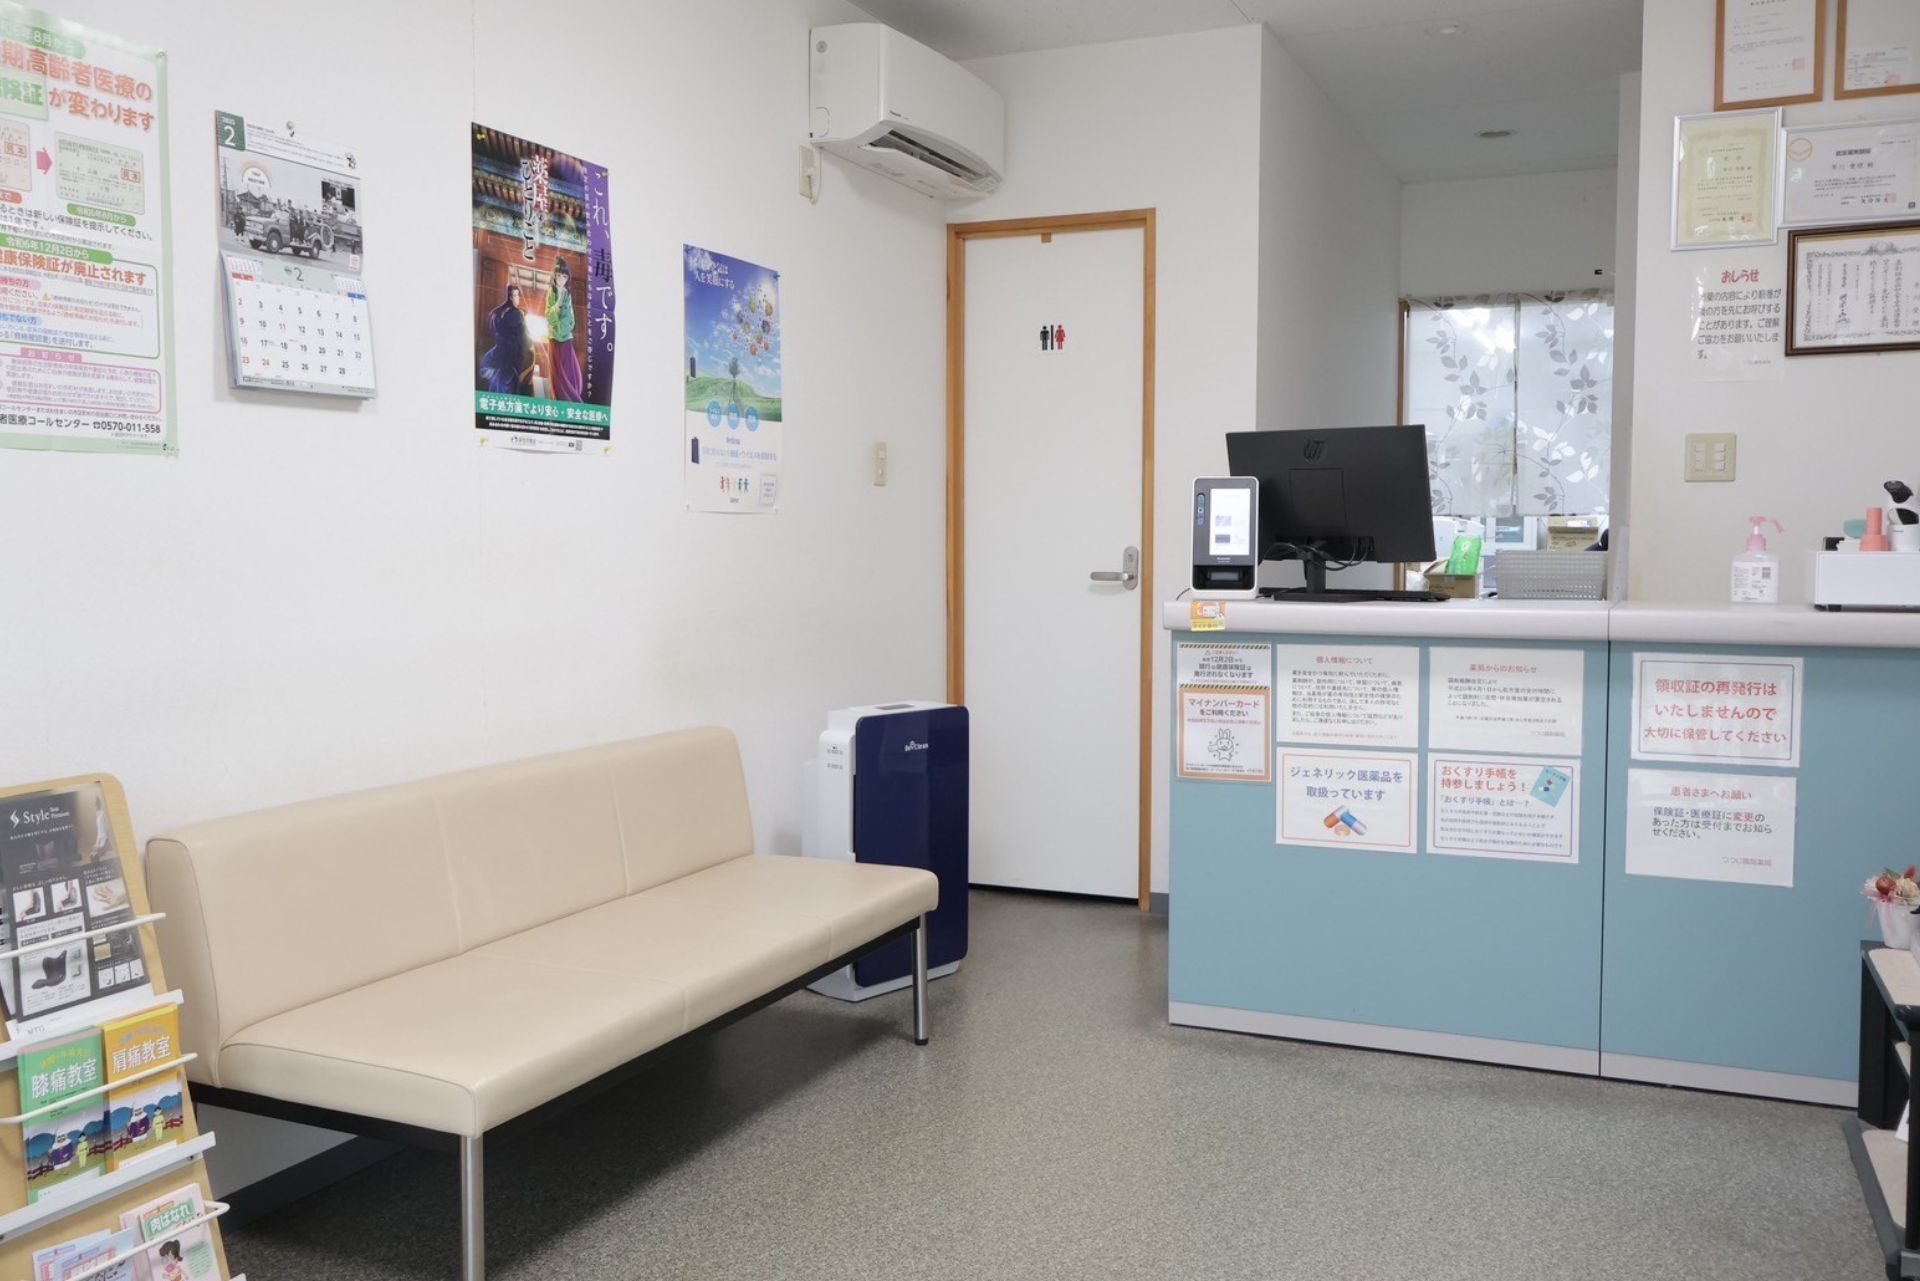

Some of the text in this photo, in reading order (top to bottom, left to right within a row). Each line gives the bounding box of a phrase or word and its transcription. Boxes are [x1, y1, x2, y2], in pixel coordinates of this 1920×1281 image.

[50, 87, 154, 132] が変わります
[224, 126, 236, 147] 2
[293, 266, 304, 282] 2
[1655, 679, 1777, 696] 領収証の再発行は
[1189, 698, 1260, 708] マイナンバーカード
[1654, 703, 1777, 721] いたしませんので
[1644, 726, 1786, 744] 大切に保管してください
[1290, 767, 1404, 783] ジェネリック医薬品を
[1441, 766, 1518, 779] おくすり手帳を
[1306, 785, 1387, 801] 取扱っています
[1670, 786, 1753, 800] 患者さまへお願い
[23, 808, 50, 825] Style
[112, 1035, 171, 1075] 肩痛教室
[32, 1058, 98, 1100] 膝痛教室
[150, 1203, 190, 1235] 肉ばなれ
